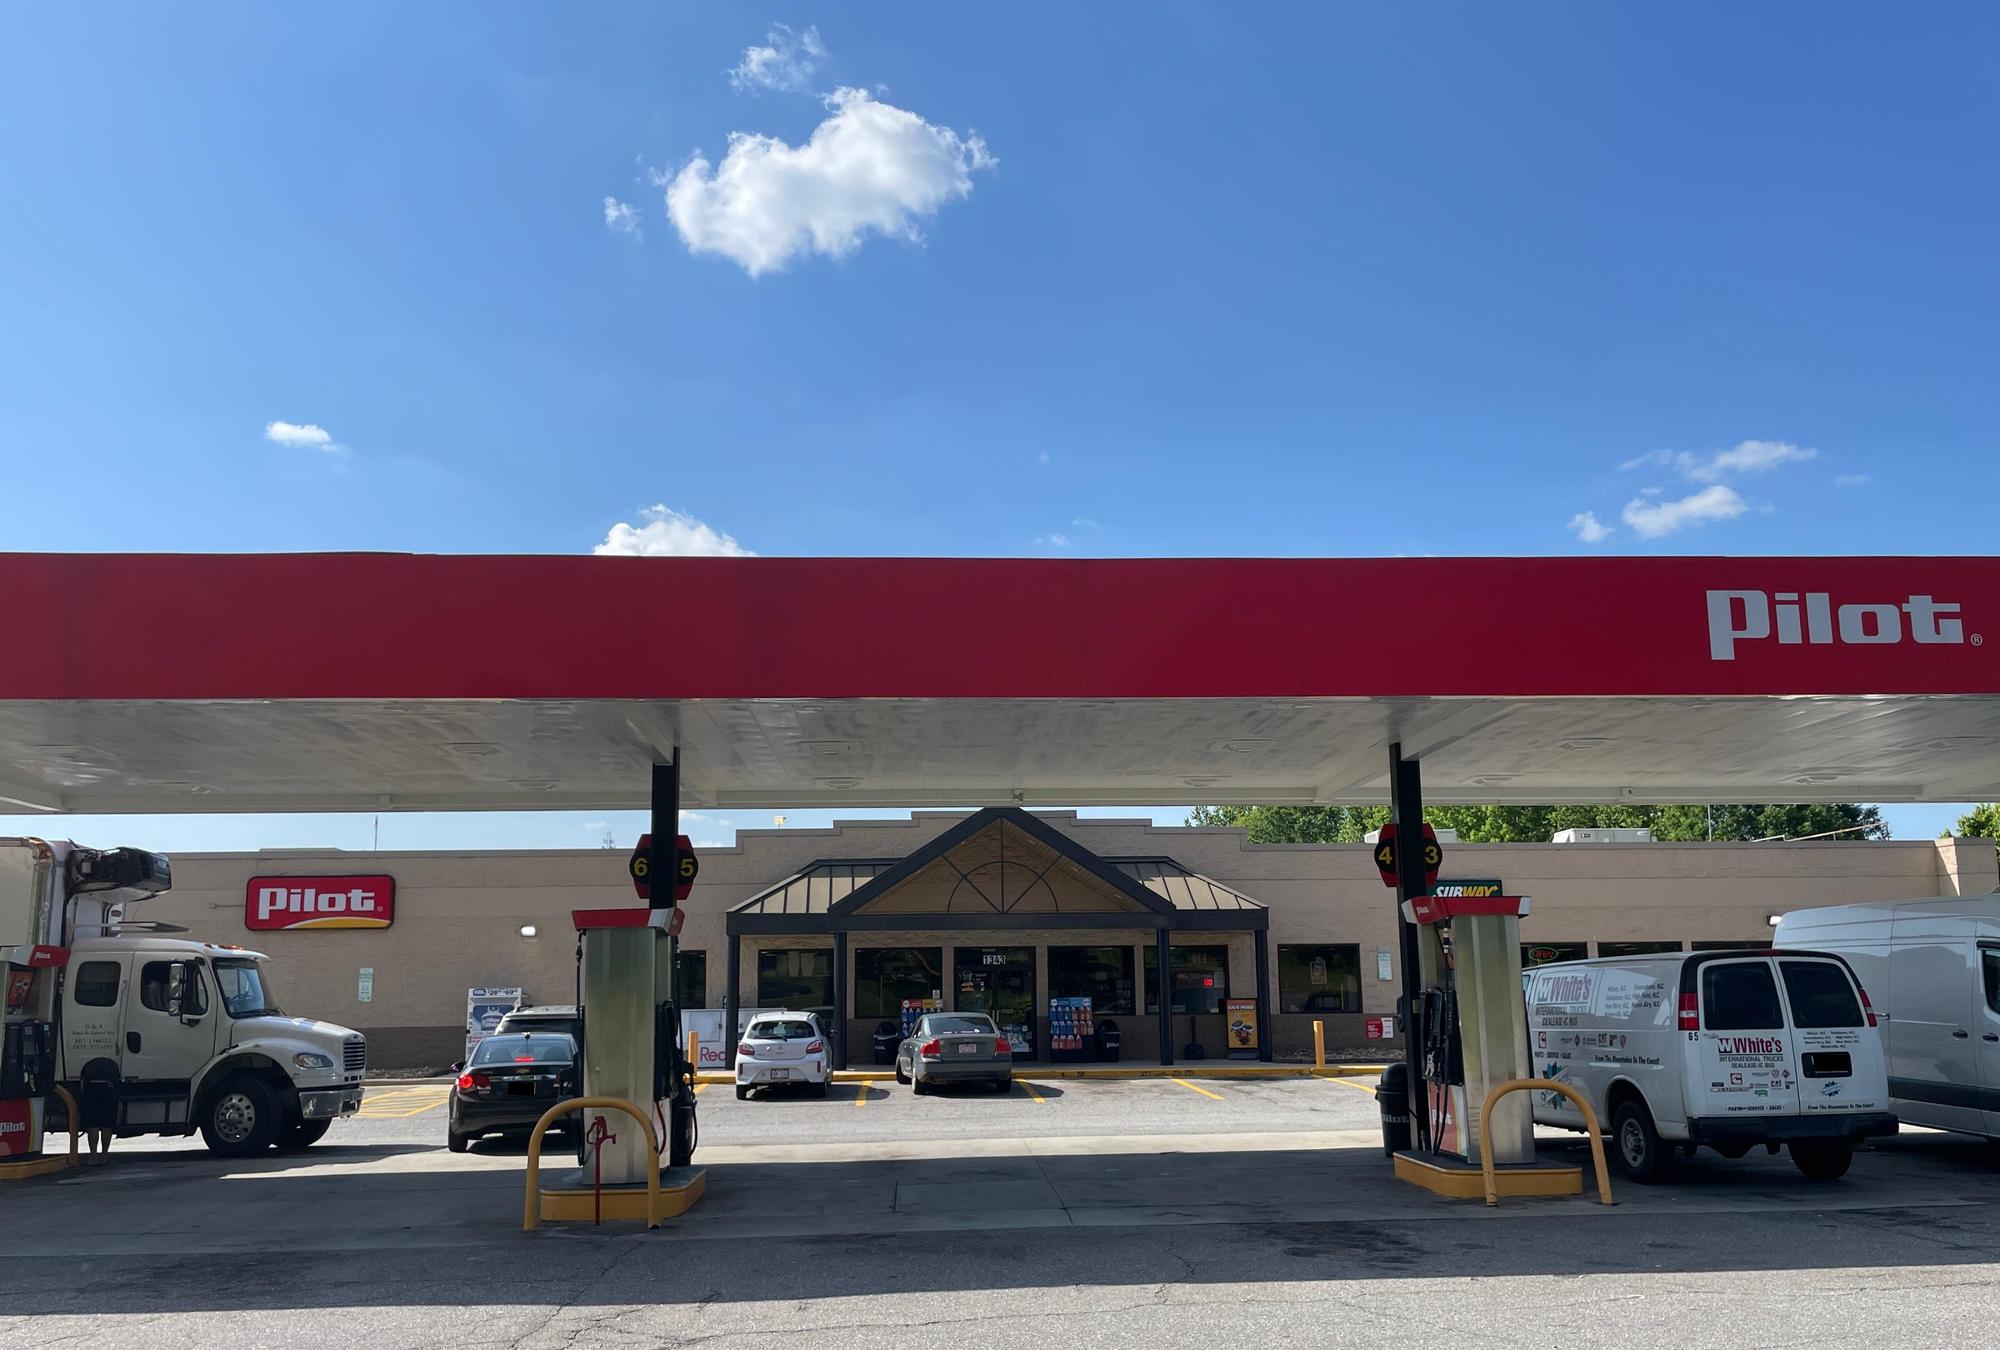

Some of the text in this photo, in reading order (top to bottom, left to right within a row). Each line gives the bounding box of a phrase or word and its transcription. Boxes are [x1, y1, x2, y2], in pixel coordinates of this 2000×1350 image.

[1706, 590, 1964, 660] Pilot
[1379, 847, 1392, 864] 4
[1425, 846, 1438, 864] 3
[634, 858, 648, 876] 6
[680, 858, 694, 877] 5
[1432, 885, 1498, 897] SUBWAY
[258, 888, 375, 920] Pilot
[1551, 974, 1591, 1002] White's
[1688, 1032, 1699, 1041] 65
[1733, 1037, 1783, 1054] White's
